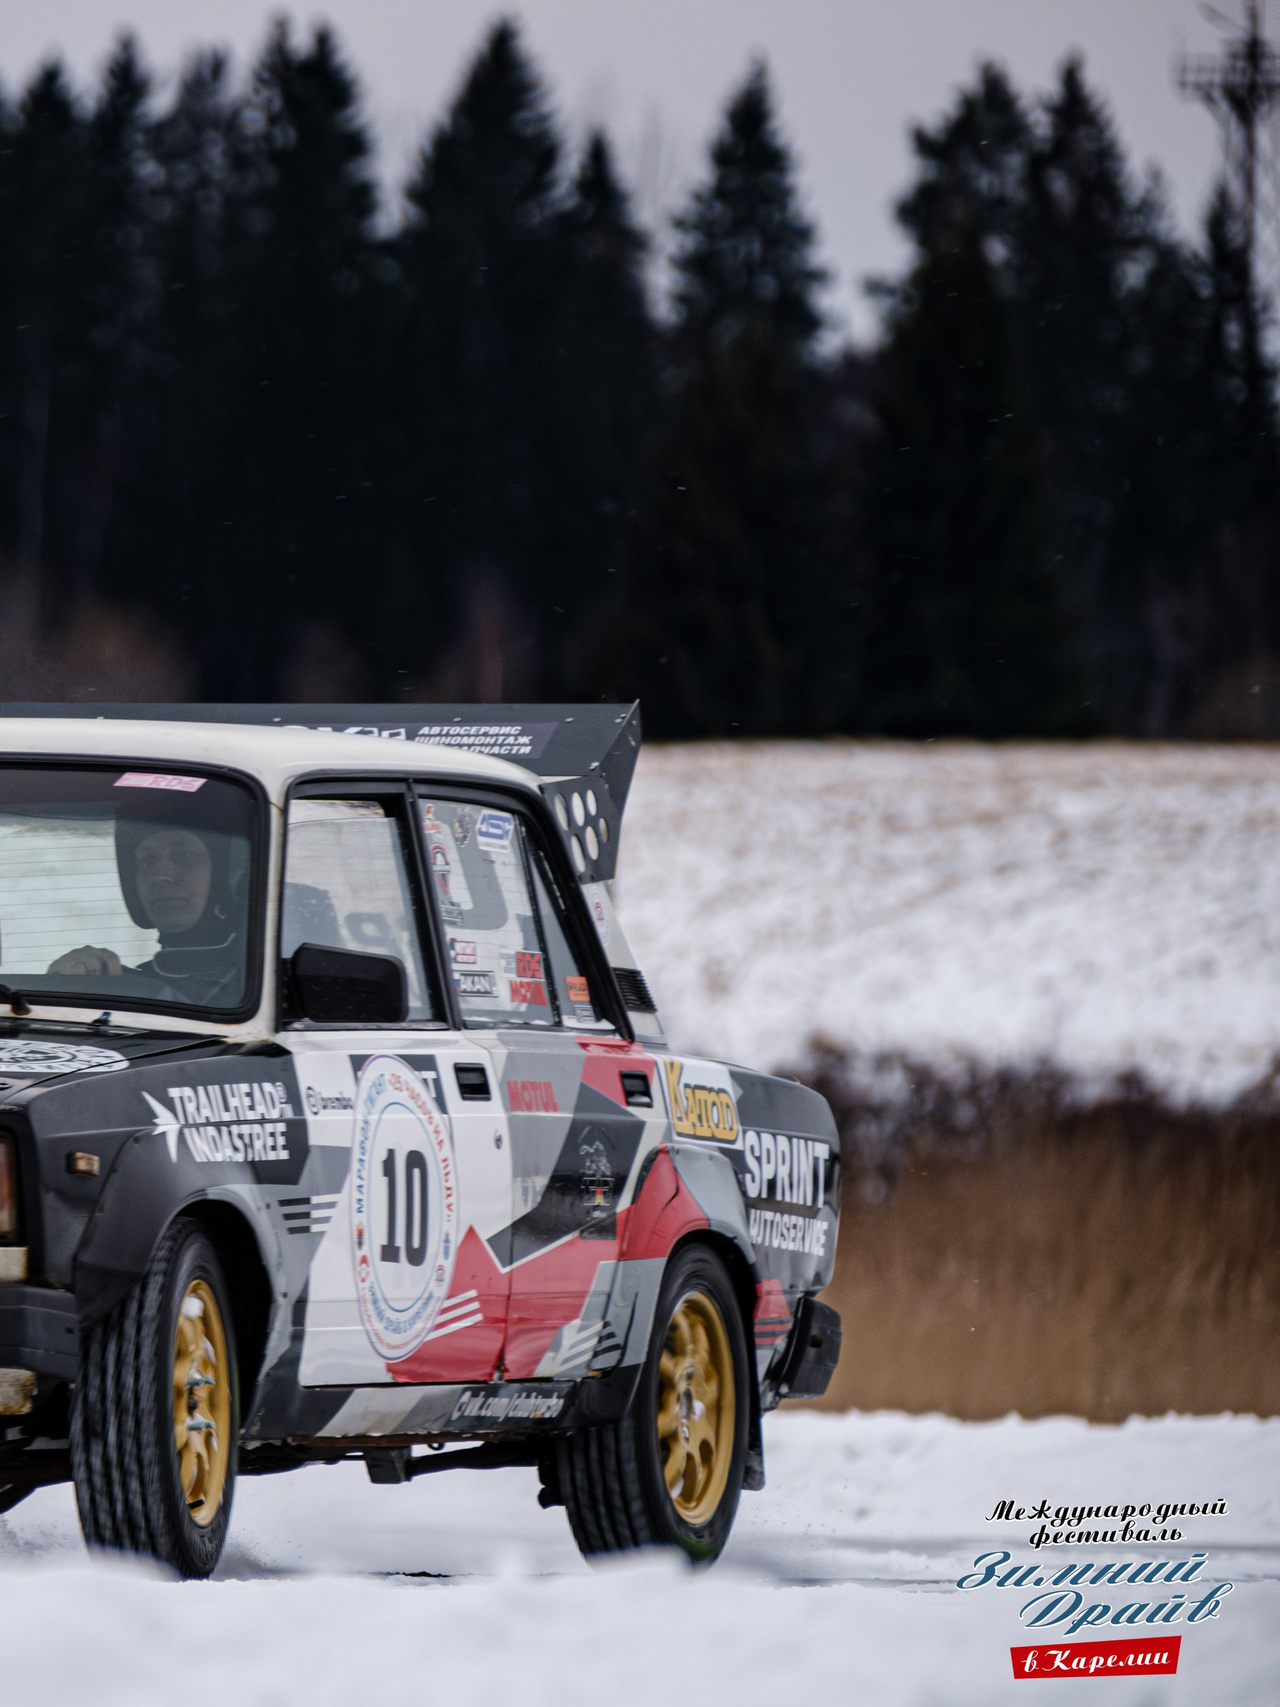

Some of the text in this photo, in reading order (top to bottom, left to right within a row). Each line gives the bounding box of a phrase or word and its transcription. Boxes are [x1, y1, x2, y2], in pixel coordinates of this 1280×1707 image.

[418, 726, 522, 735] АВТОСЕРВИС
[167, 1082, 283, 1125] TRAILHEAD
[506, 1081, 559, 1112] MOTUL
[182, 1122, 291, 1163] INDASTREE
[744, 1130, 830, 1208] SPRINT
[380, 1149, 429, 1266] 10
